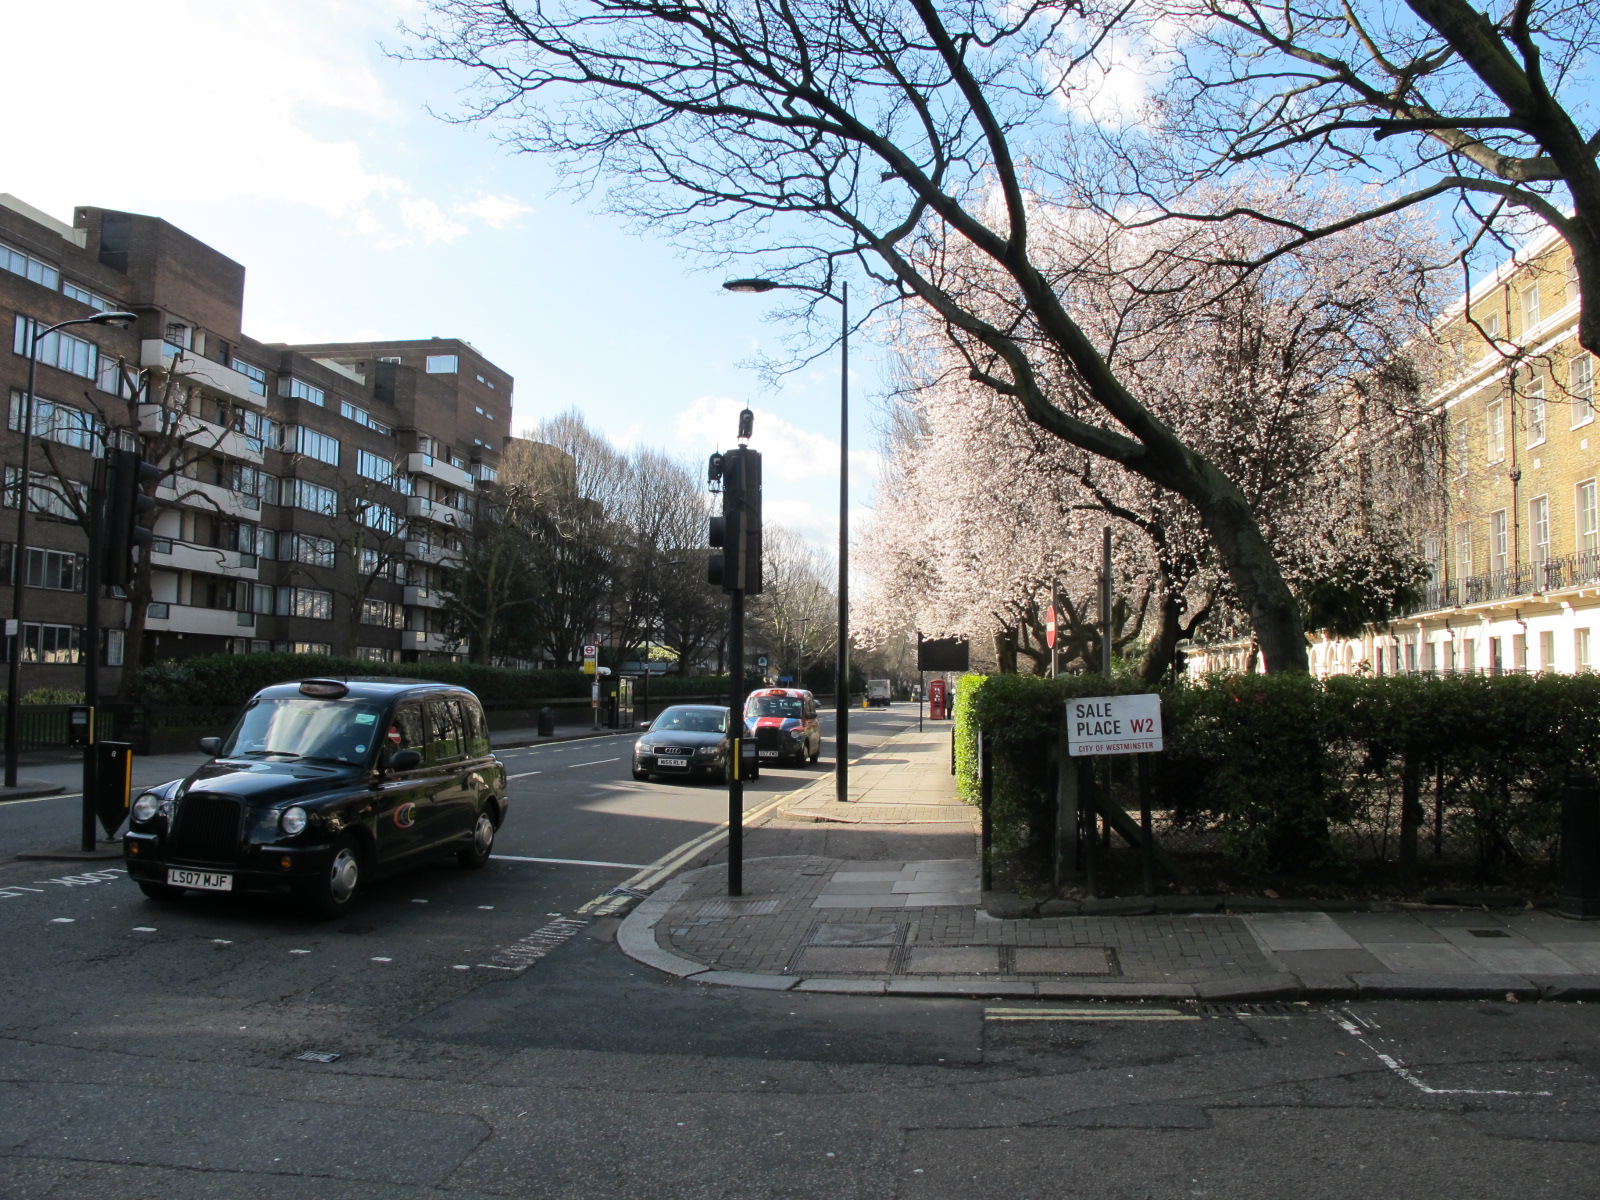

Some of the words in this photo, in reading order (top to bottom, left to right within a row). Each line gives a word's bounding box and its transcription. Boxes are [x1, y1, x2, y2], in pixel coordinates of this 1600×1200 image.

[1076, 703, 1112, 719] SALE
[1077, 720, 1121, 736] PLACE
[1130, 718, 1154, 733] W2
[1078, 744, 1093, 753] CITY
[1095, 744, 1104, 752] OF
[1105, 741, 1154, 751] WESTMINSTER
[172, 871, 201, 885] LS07
[203, 874, 227, 887] MJF
